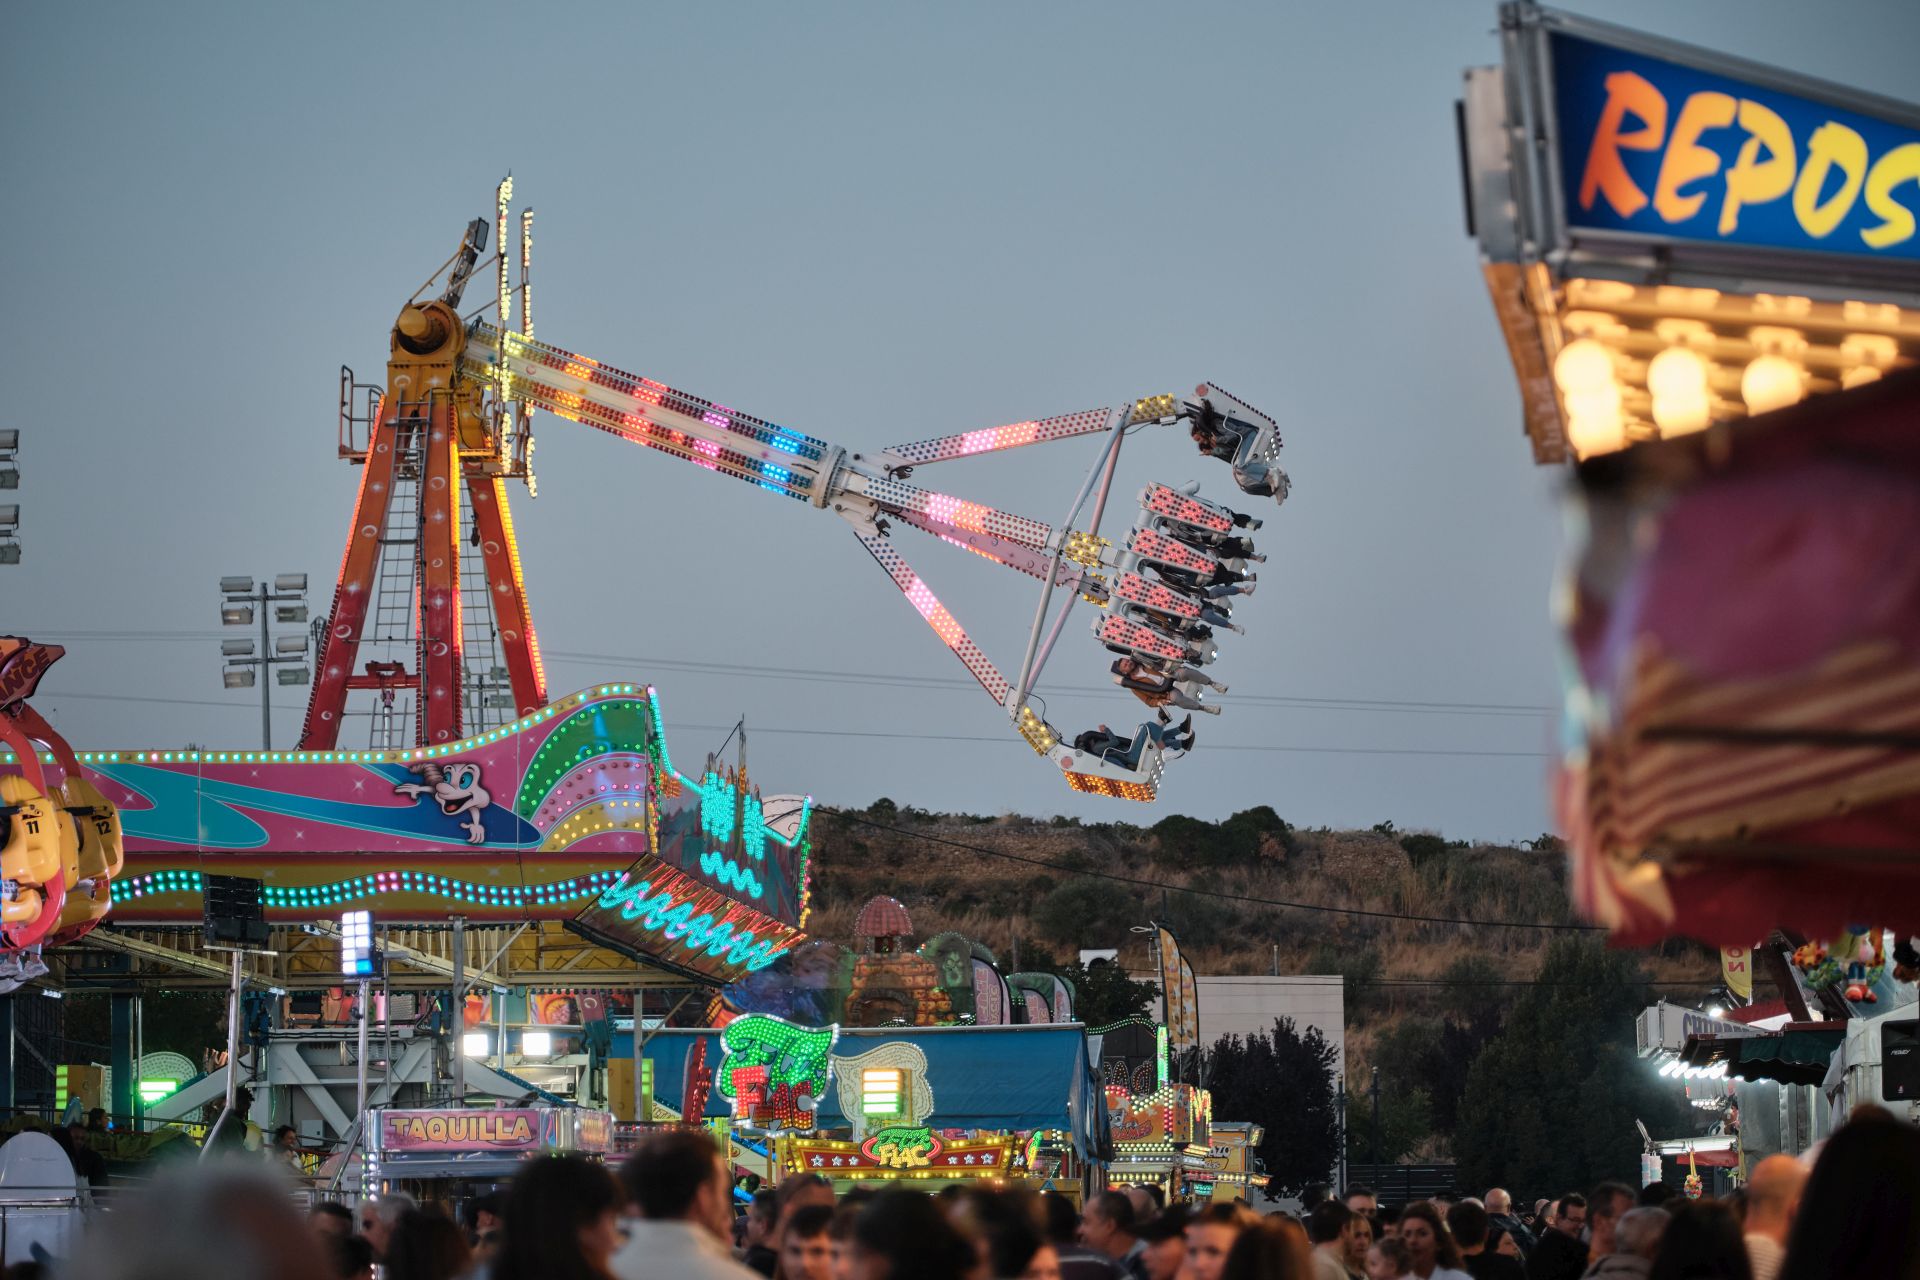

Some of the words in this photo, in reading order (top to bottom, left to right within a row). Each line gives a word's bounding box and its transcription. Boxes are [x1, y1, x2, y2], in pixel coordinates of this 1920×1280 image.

[26, 820, 40, 835] 11
[96, 820, 112, 836] 12
[731, 1064, 813, 1131] FLAC
[390, 1116, 533, 1144] TAQUILLA
